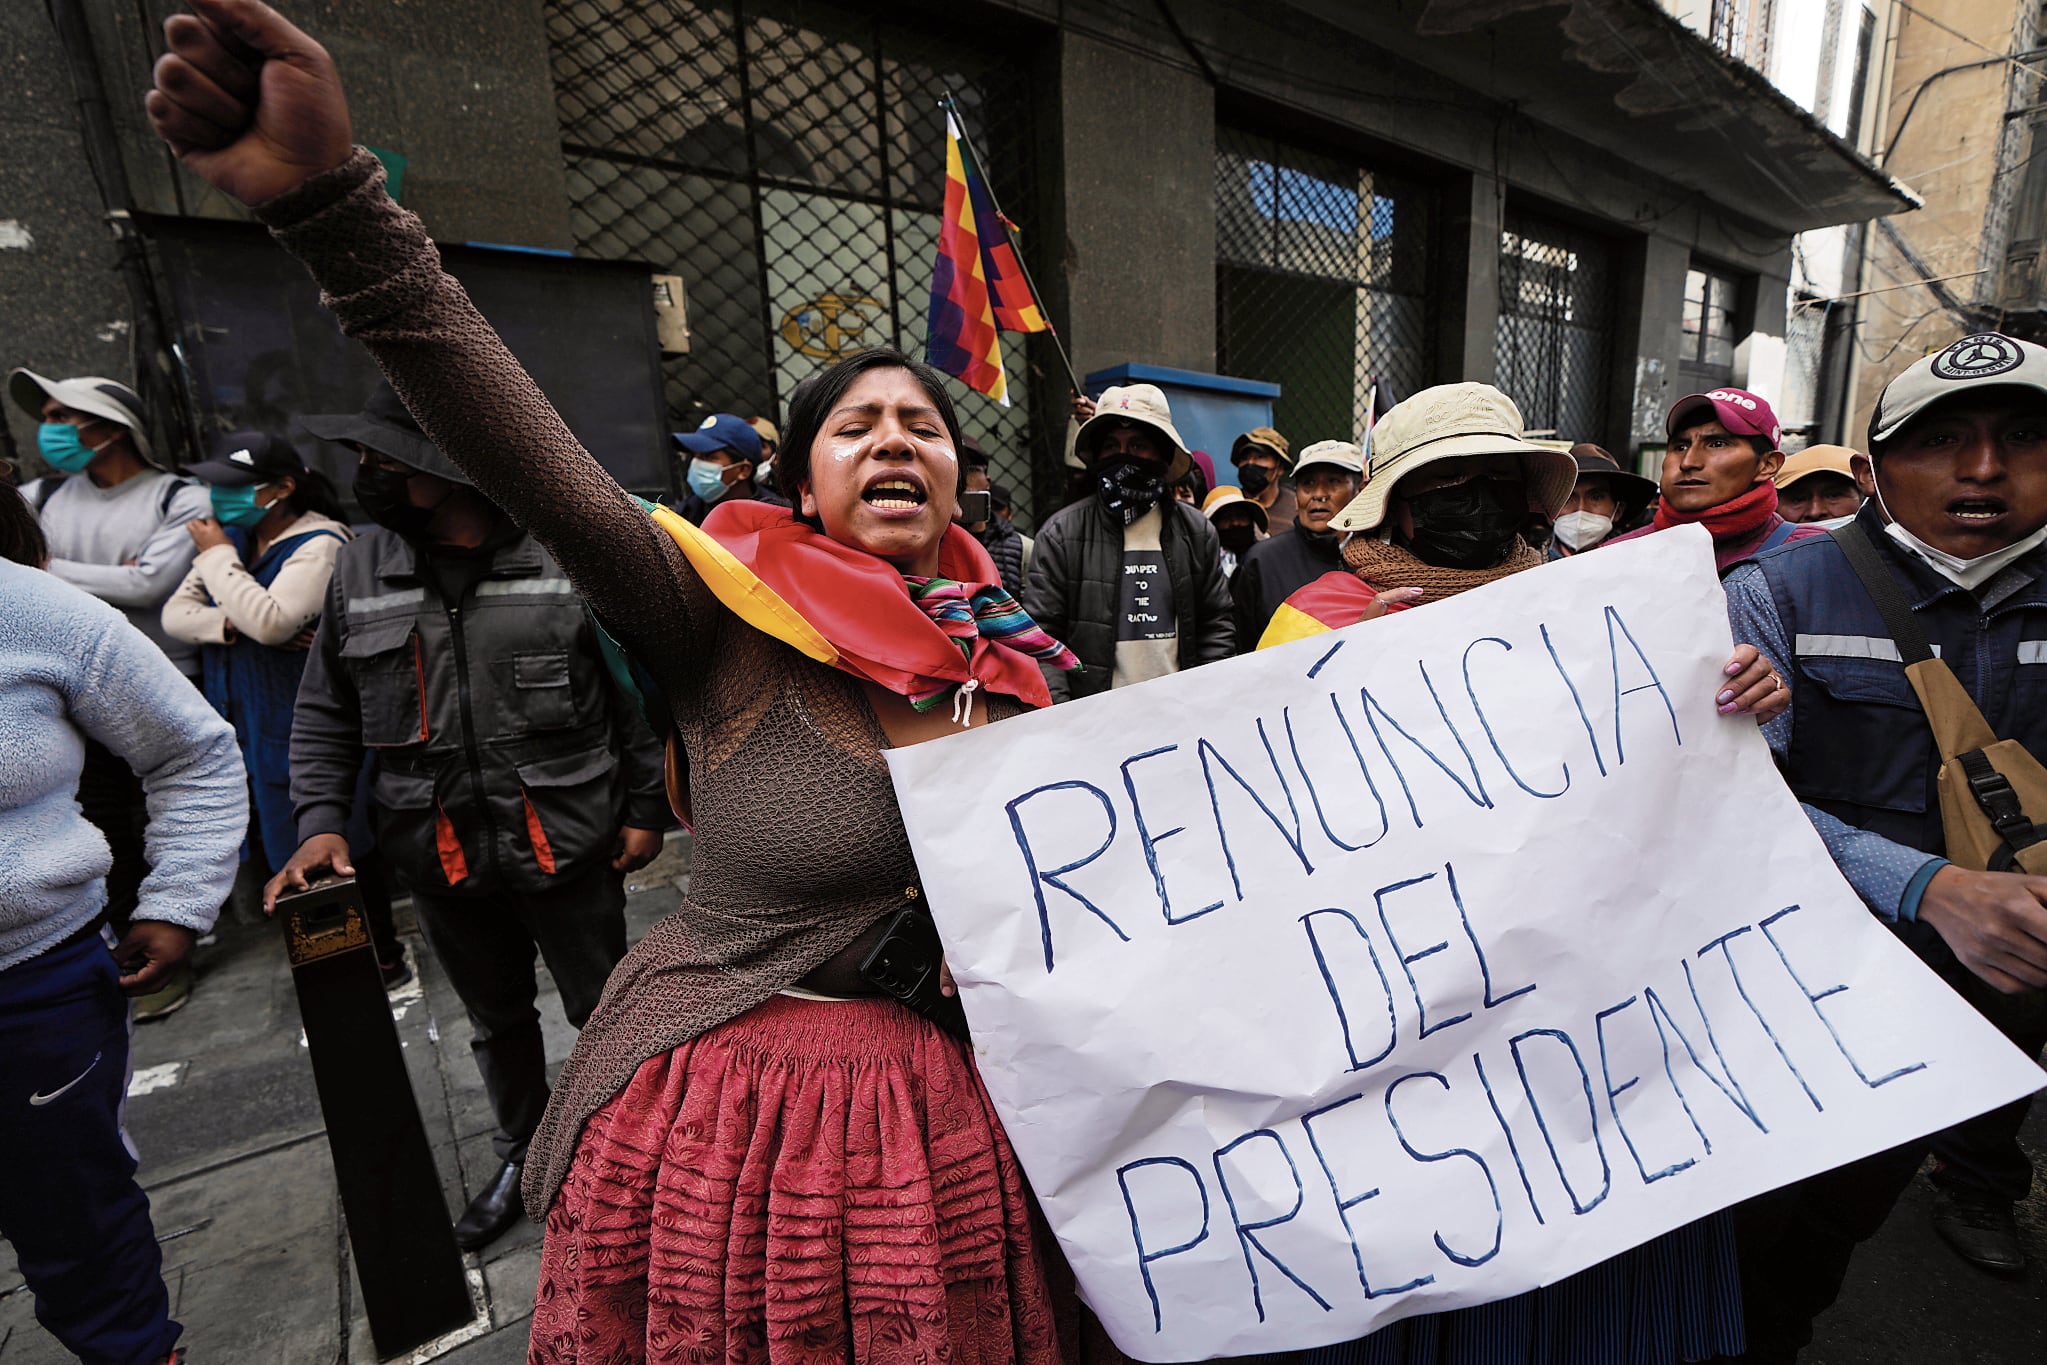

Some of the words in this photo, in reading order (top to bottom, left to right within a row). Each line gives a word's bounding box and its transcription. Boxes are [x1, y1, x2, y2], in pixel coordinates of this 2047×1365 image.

[1705, 390, 1757, 411] one
[1005, 604, 1683, 976] RENÚNCIA
[1298, 862, 1537, 1074] DEL
[1116, 904, 1930, 1333] PRESIDENTE
